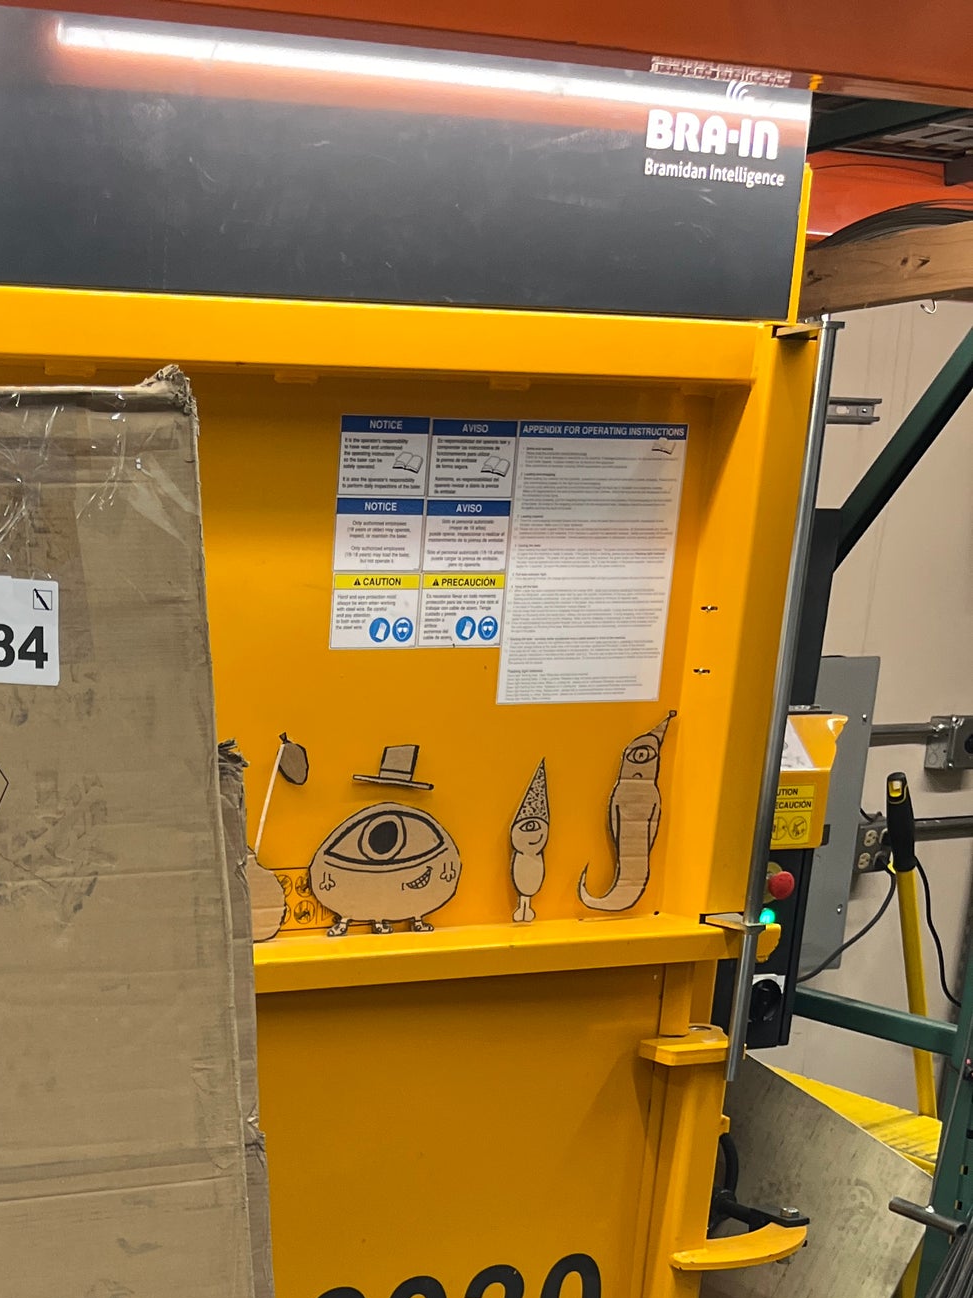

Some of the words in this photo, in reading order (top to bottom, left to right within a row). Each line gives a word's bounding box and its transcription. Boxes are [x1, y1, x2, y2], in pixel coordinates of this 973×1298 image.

[646, 108, 779, 160] BRA-IN
[644, 157, 707, 179] Bramidan
[709, 164, 785, 188] Intelligence
[370, 420, 403, 429] NOTICE
[462, 424, 489, 432] AVISO
[523, 425, 562, 434] APPENDIX
[564, 426, 580, 435] FOR
[582, 426, 627, 436] OPERATING
[629, 427, 685, 437] INSTRUCTIONS
[365, 502, 397, 511] NOTICE
[456, 504, 482, 512] AVISO
[441, 576, 496, 586] PRECAUCIÓN
